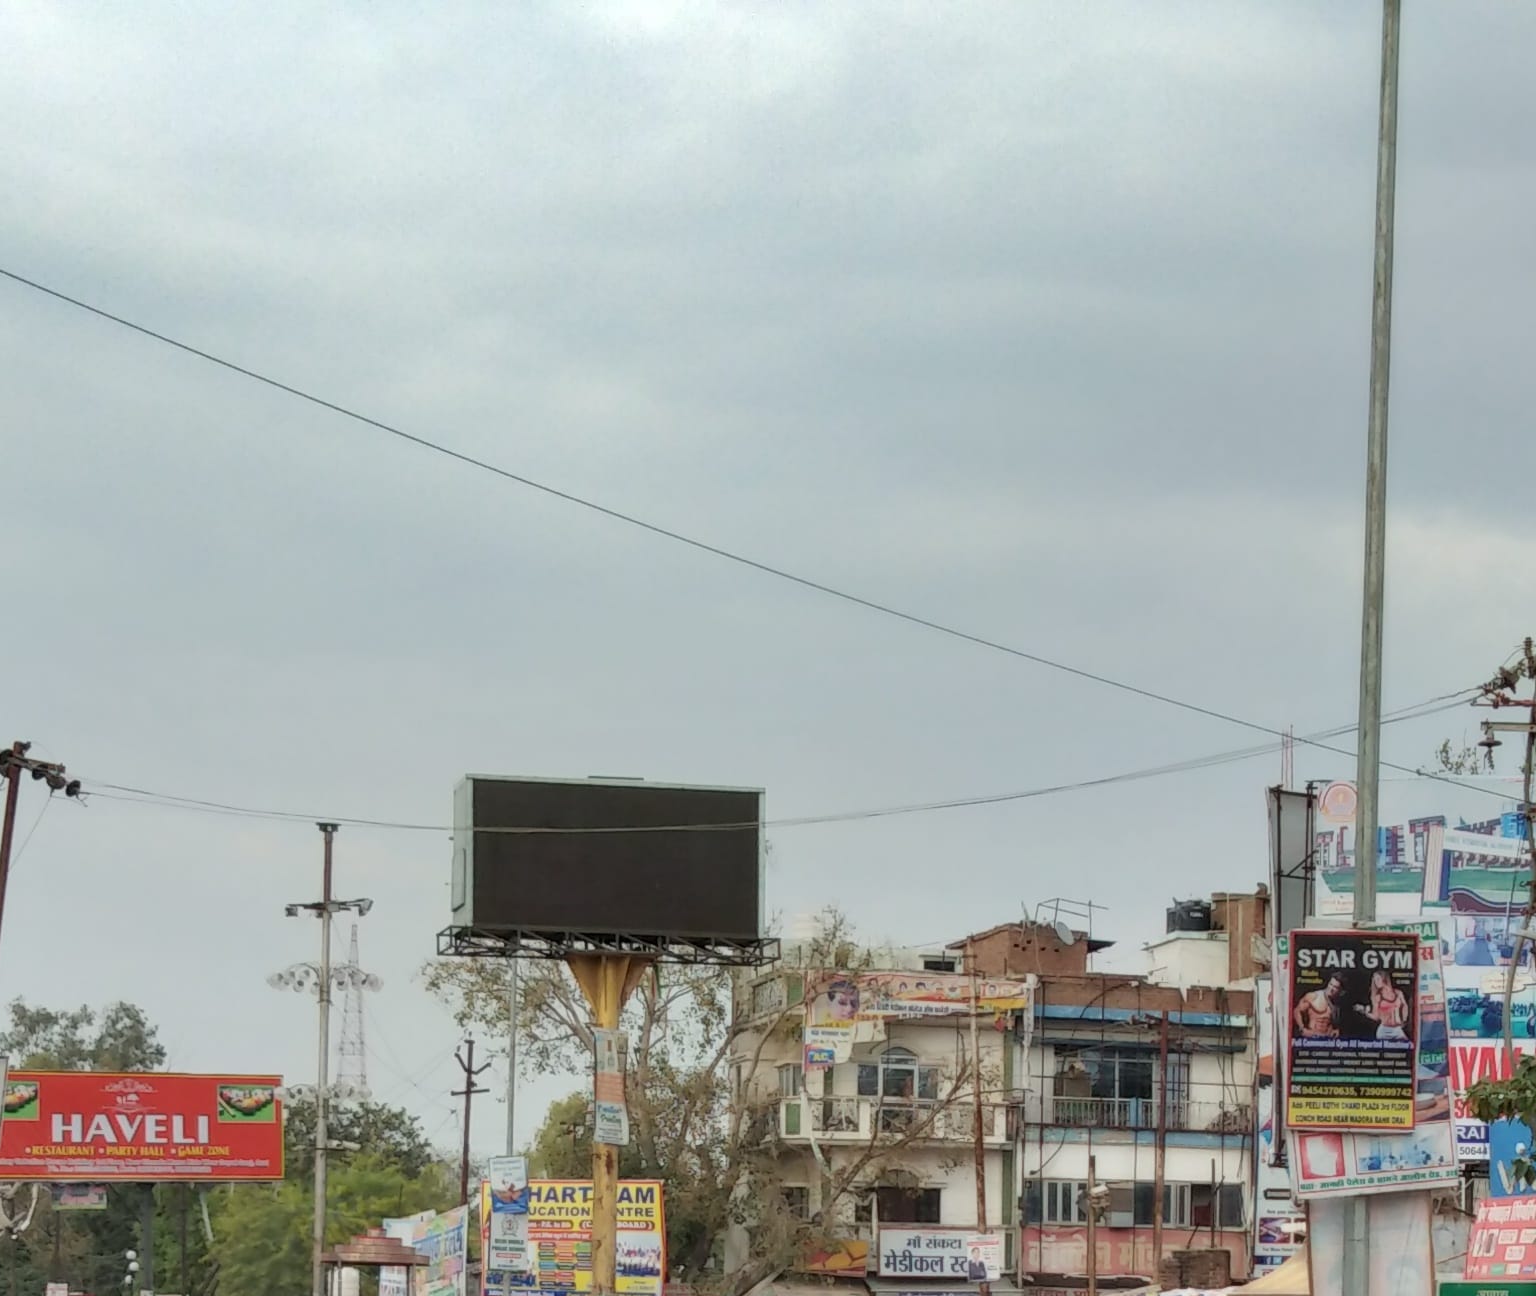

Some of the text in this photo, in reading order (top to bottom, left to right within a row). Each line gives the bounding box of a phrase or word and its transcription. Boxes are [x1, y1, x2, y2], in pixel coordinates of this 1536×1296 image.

[1297, 949, 1356, 968] STAR
[1362, 950, 1413, 969] GYM
[51, 1113, 210, 1144] HAVELI
[1455, 1126, 1485, 1139] RAI
[32, 1146, 230, 1157] RESTAURANT PARTY HALL GAME ZONE
[528, 1207, 590, 1217] UCATION
